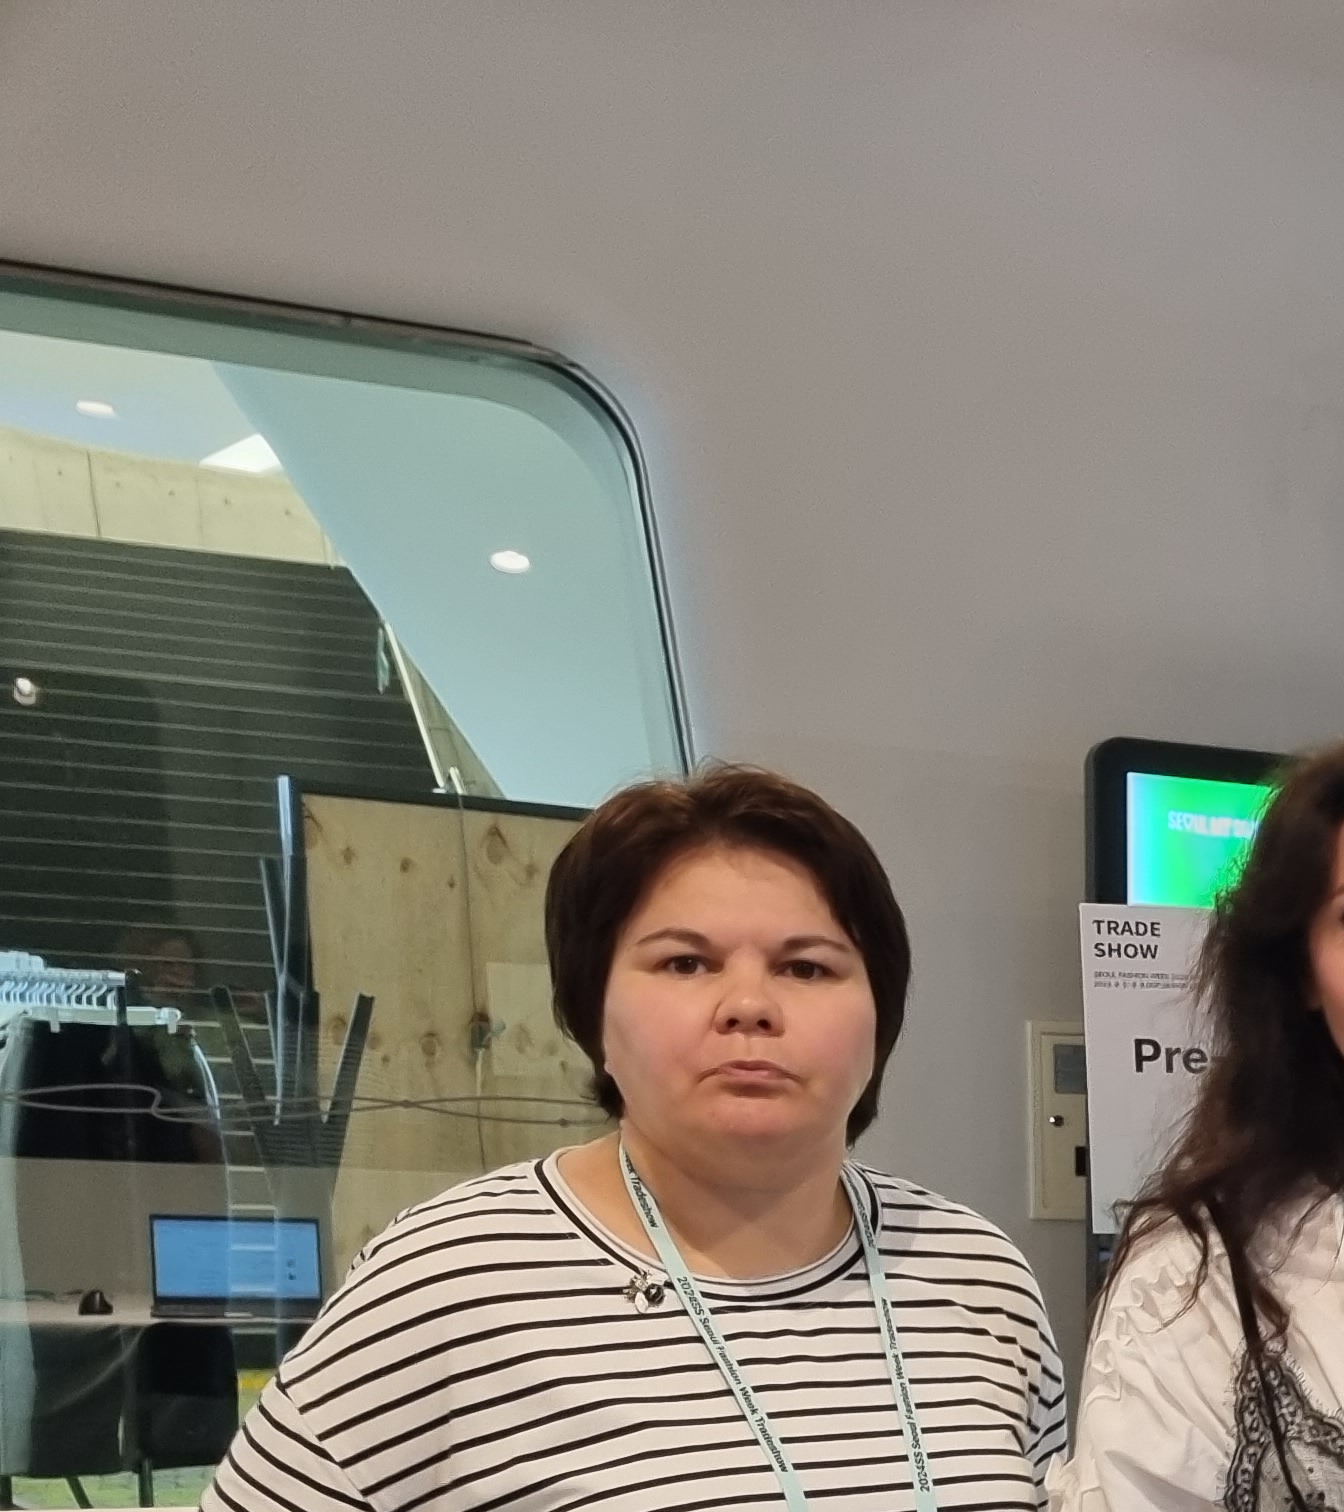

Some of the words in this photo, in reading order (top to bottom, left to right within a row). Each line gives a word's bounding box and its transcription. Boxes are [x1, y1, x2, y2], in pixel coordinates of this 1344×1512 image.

[1092, 919, 1161, 938] TRADE
[1093, 942, 1159, 959] SHOW
[911, 1450, 930, 1493] 2024SS
